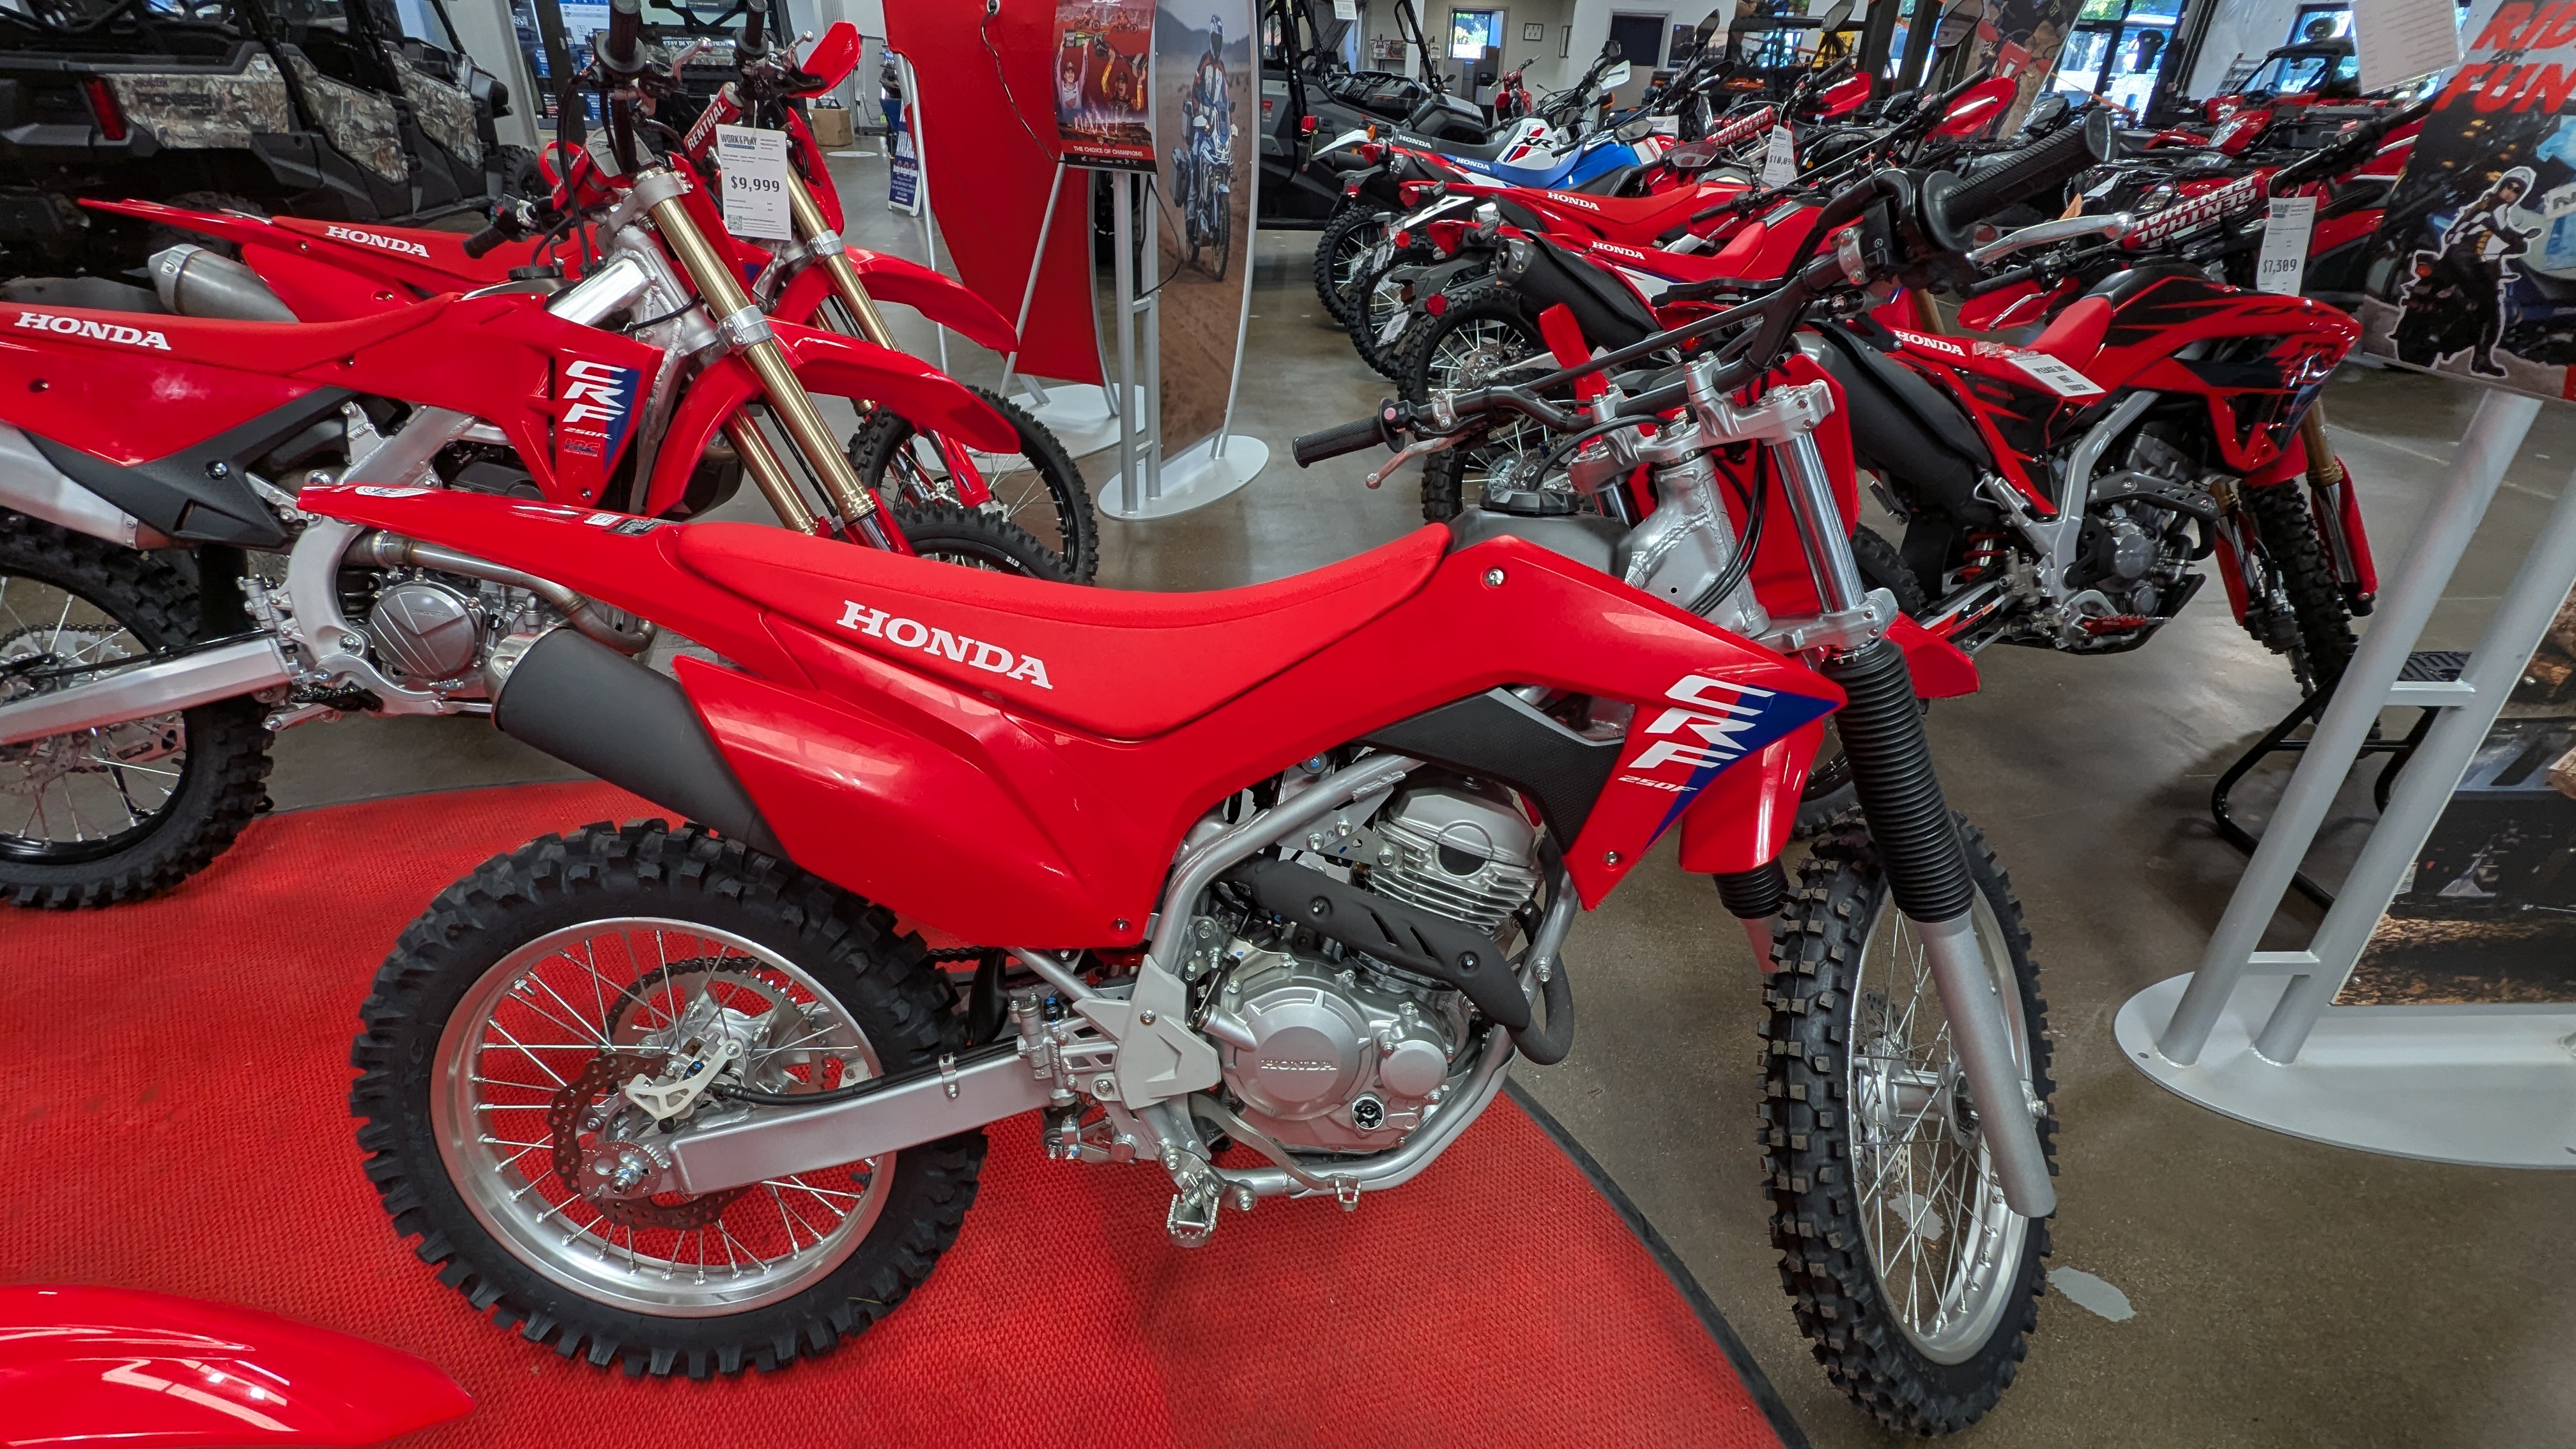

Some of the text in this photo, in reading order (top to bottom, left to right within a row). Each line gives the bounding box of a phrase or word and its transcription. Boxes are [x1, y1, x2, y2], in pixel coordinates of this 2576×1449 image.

[2470, 1, 2576, 50] RID
[135, 93, 212, 107] PIONEER
[2432, 63, 2576, 114] FUN
[687, 101, 726, 151] RENTHAL
[1399, 134, 1432, 148] HONDA
[1517, 137, 1554, 150] XR
[1456, 157, 1490, 171] HONDA
[731, 175, 780, 192] $9,999
[1547, 192, 1600, 211] HONDA
[2134, 188, 2257, 243] RENTHAL
[325, 225, 429, 257] HONDA
[1591, 241, 1646, 260] HONDA
[15, 311, 171, 351] HONDA
[1893, 329, 1966, 357] HONDA
[562, 360, 628, 423] CRF
[564, 427, 613, 440] 250R
[837, 599, 1054, 690] HONDA
[1628, 675, 1777, 769] CRF
[1617, 775, 1699, 792] 250F
[1261, 1059, 1337, 1071] HONDA
